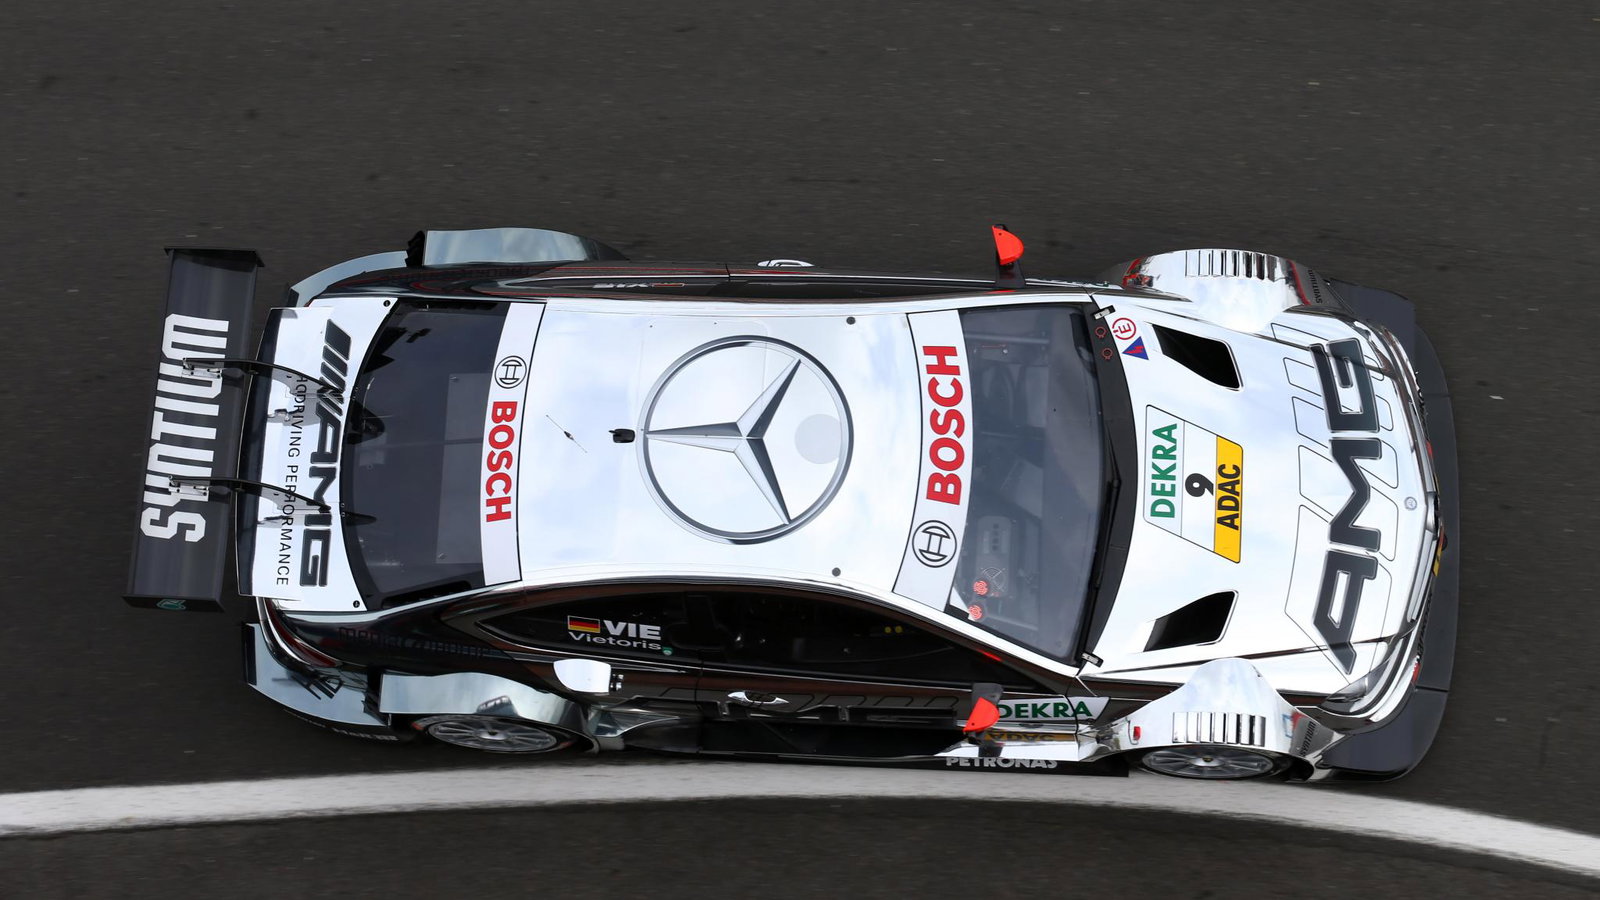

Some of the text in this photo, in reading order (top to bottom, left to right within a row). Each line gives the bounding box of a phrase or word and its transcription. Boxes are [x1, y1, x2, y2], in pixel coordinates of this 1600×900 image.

[140, 313, 229, 543] SYNTIUM
[485, 401, 518, 523] BOSCH
[922, 345, 965, 506] BOSCH
[1150, 423, 1178, 519] DEKRA
[276, 394, 306, 586] DRIVING PERORMANCE
[1184, 472, 1214, 498] 9
[1216, 463, 1241, 531] ADAC
[1309, 337, 1382, 676] AMG
[568, 631, 662, 651] Vietoris
[603, 619, 661, 641] VIE
[945, 756, 1058, 769] PETRONAS
